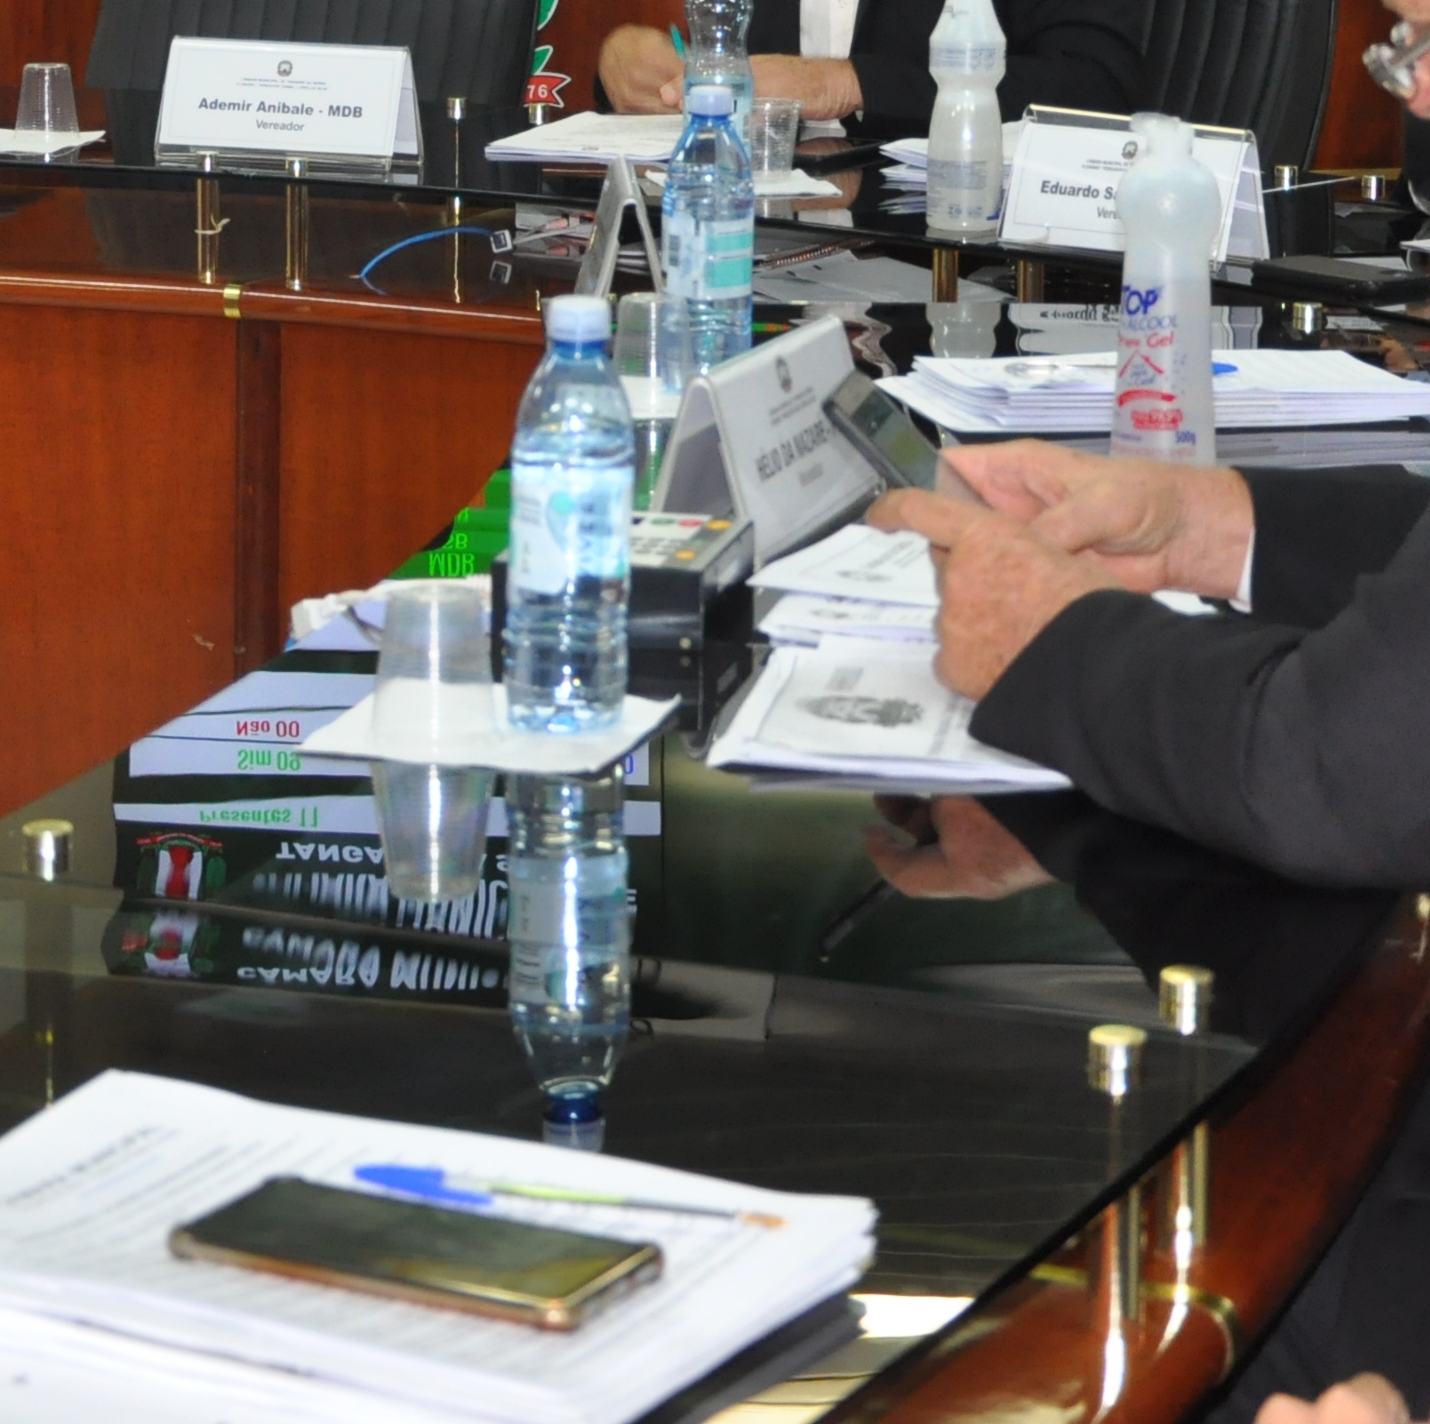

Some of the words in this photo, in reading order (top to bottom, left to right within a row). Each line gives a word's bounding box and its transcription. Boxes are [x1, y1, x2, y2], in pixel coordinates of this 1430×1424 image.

[198, 97, 252, 113] Ademir
[255, 100, 314, 116] Anibale
[327, 104, 363, 119] MDB
[255, 118, 305, 132] Vereador
[1040, 180, 1100, 200] Eduardo
